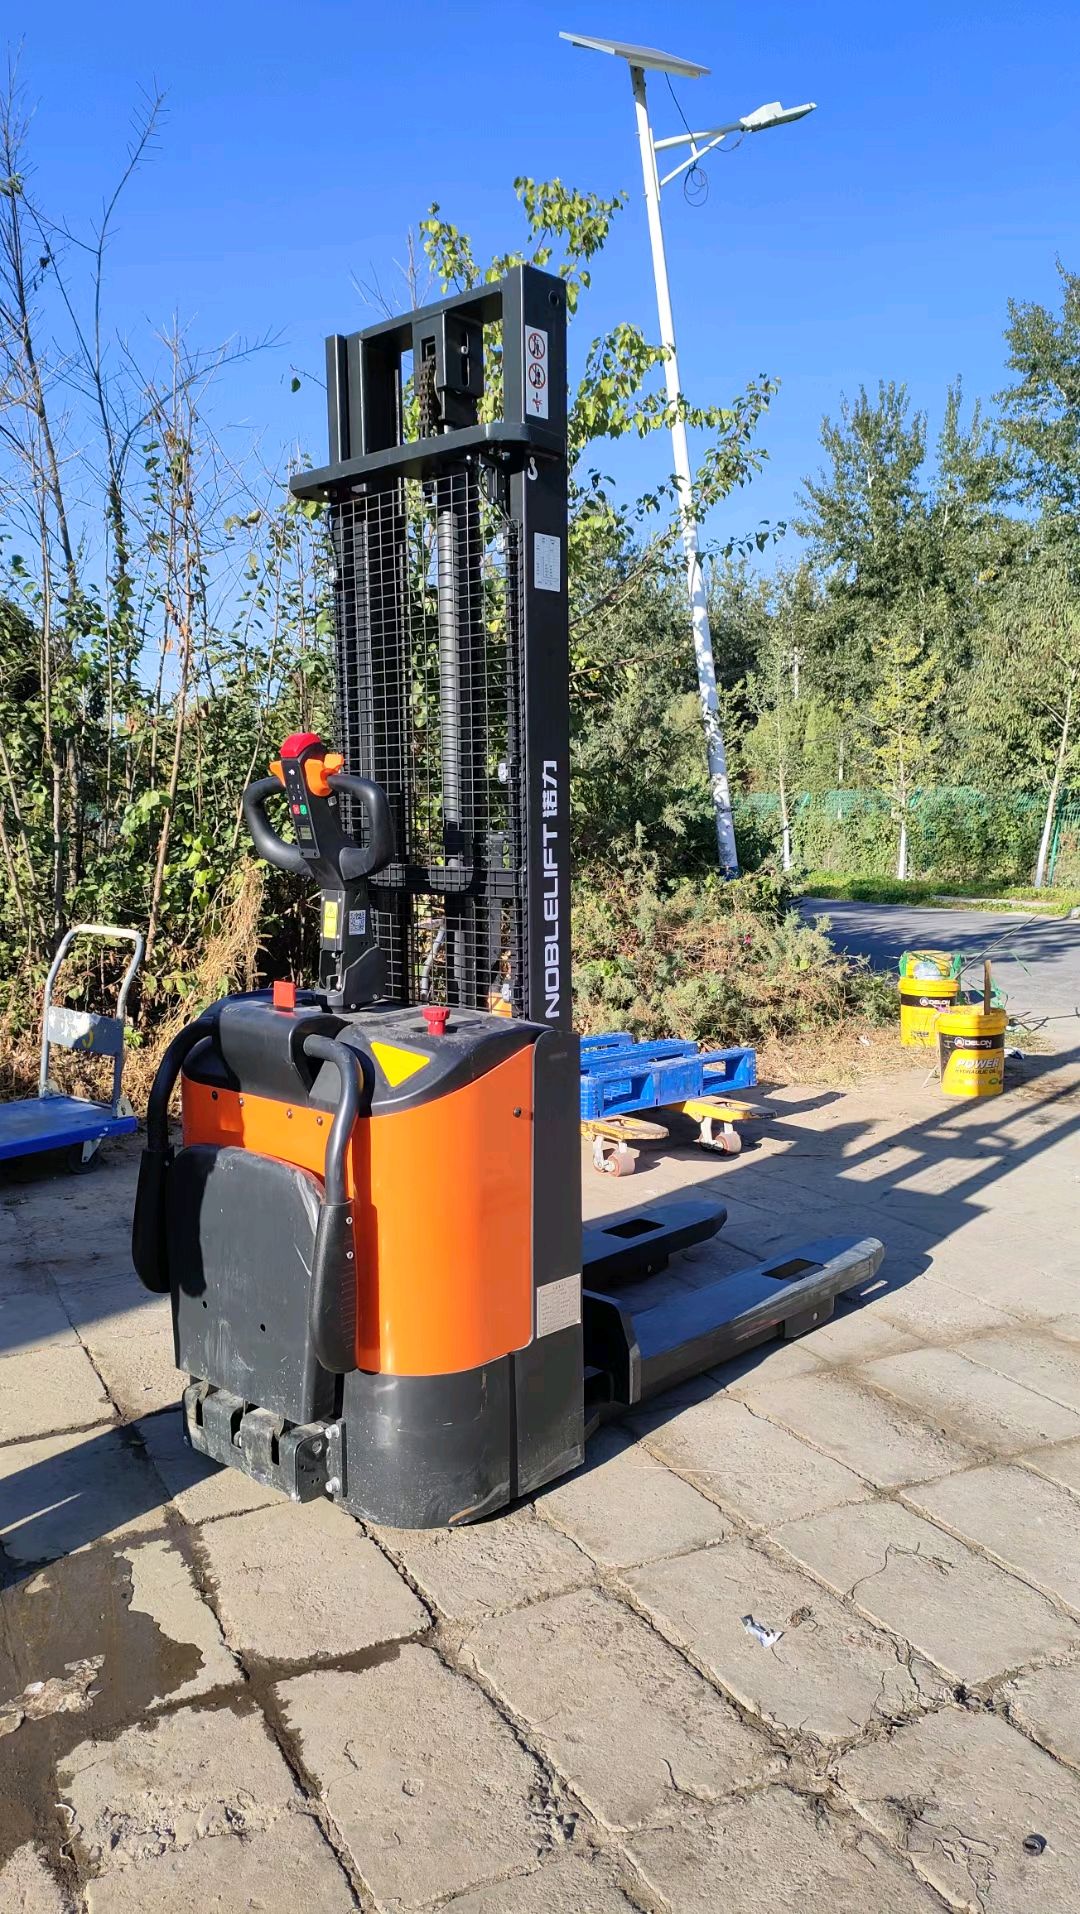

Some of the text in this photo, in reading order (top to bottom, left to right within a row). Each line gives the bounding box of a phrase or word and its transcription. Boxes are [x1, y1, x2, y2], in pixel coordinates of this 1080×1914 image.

[542, 760, 560, 1019] NOBLELIFT 诺力
[957, 1058, 1000, 1069] POWER
